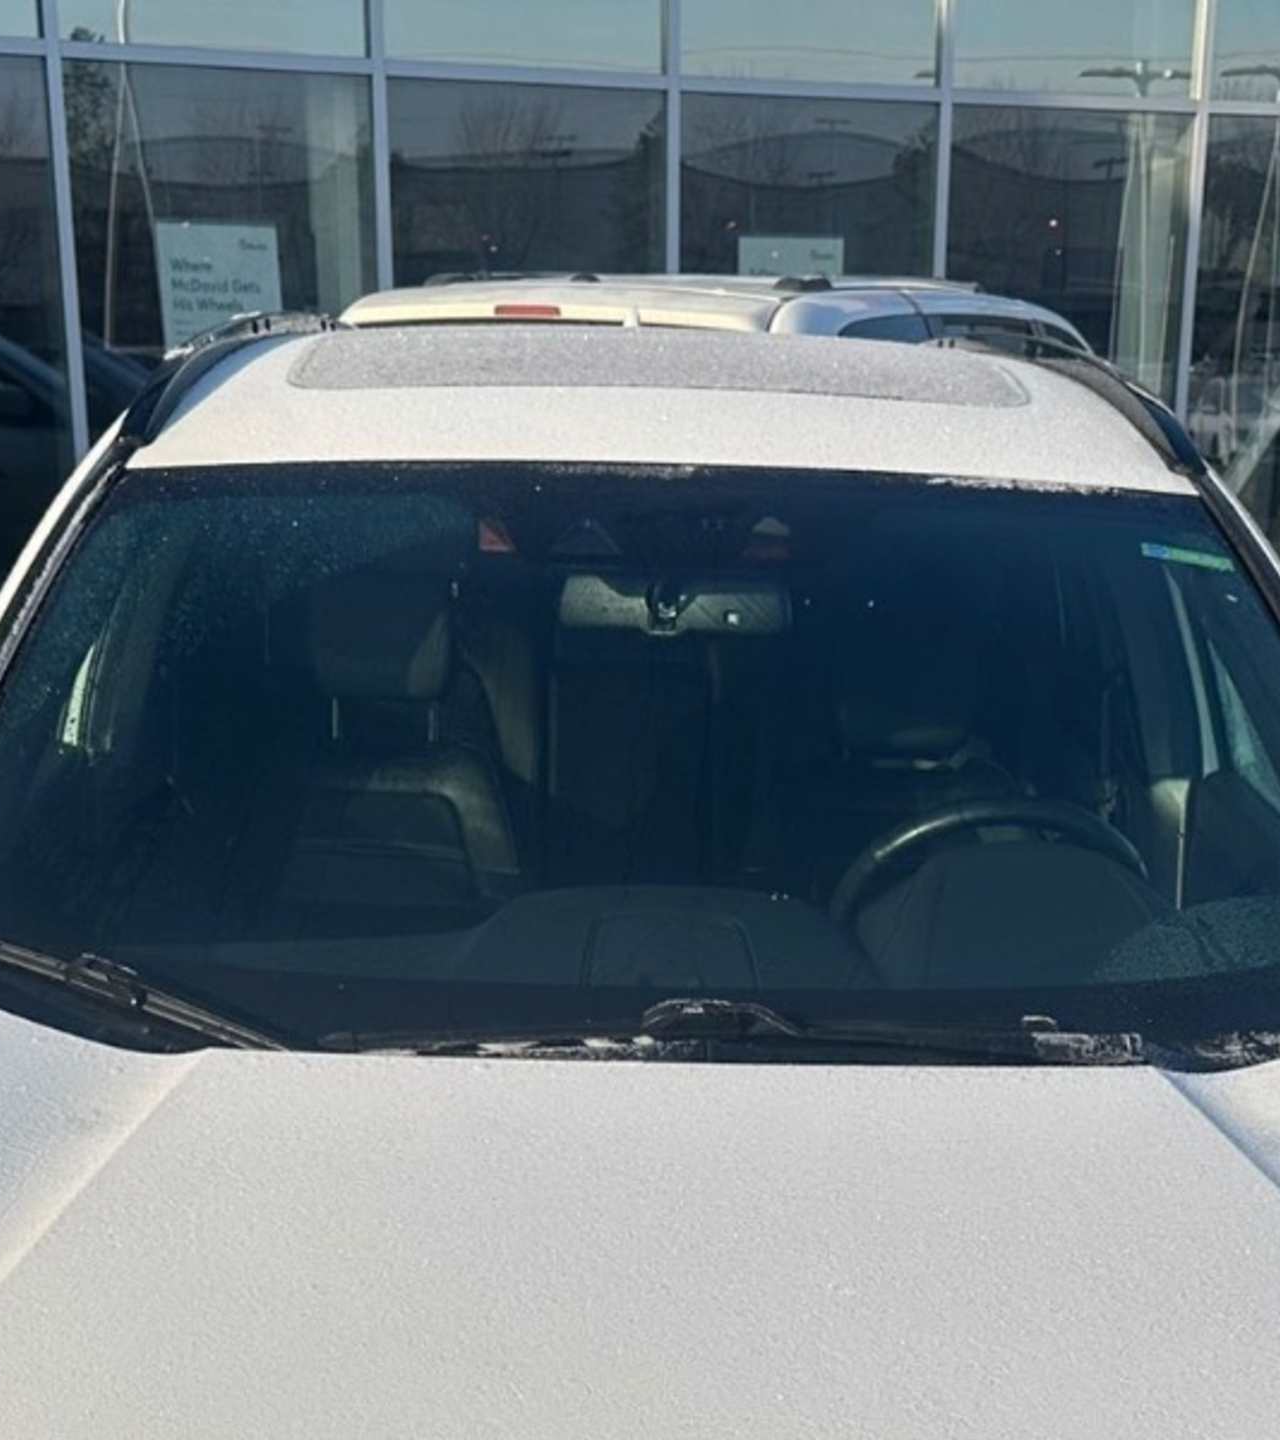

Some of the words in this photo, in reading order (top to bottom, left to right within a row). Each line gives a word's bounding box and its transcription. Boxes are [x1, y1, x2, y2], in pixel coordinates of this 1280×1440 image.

[170, 257, 213, 271] Where
[171, 277, 229, 293] McDavid
[231, 278, 262, 294] Gets
